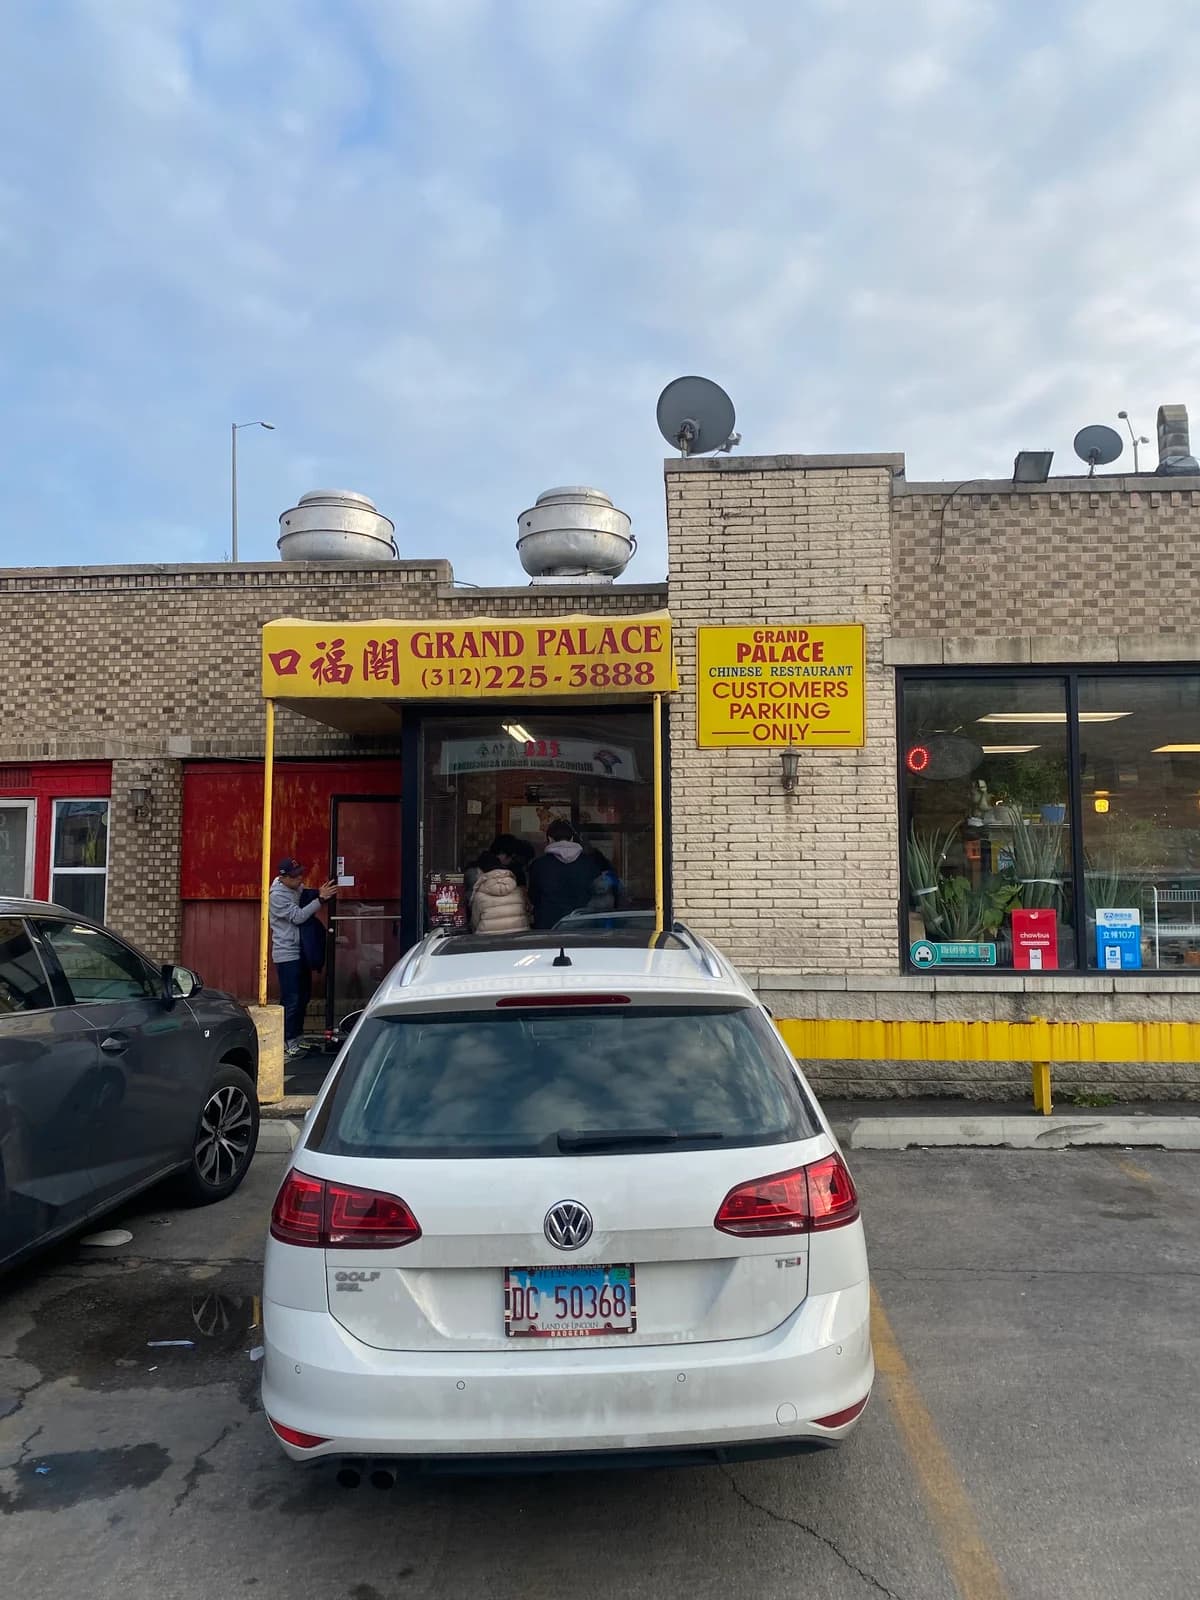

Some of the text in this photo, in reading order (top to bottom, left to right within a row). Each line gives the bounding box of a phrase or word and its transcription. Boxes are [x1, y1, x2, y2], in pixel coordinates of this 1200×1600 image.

[410, 625, 664, 659] GRAND PALACE
[753, 630, 809, 643] GRAND
[736, 642, 824, 663] PALACE
[709, 666, 853, 678] CHINESE RESTAURANT
[712, 681, 848, 699] CUSTOMERS
[729, 702, 831, 720] PARKING
[752, 723, 810, 741] ONLY
[775, 1257, 801, 1268] TSI
[335, 1271, 380, 1281] GOLF
[512, 1283, 626, 1320] DC 50368
[541, 1322, 560, 1330] LAND
[571, 1320, 599, 1329] LINCOLN
